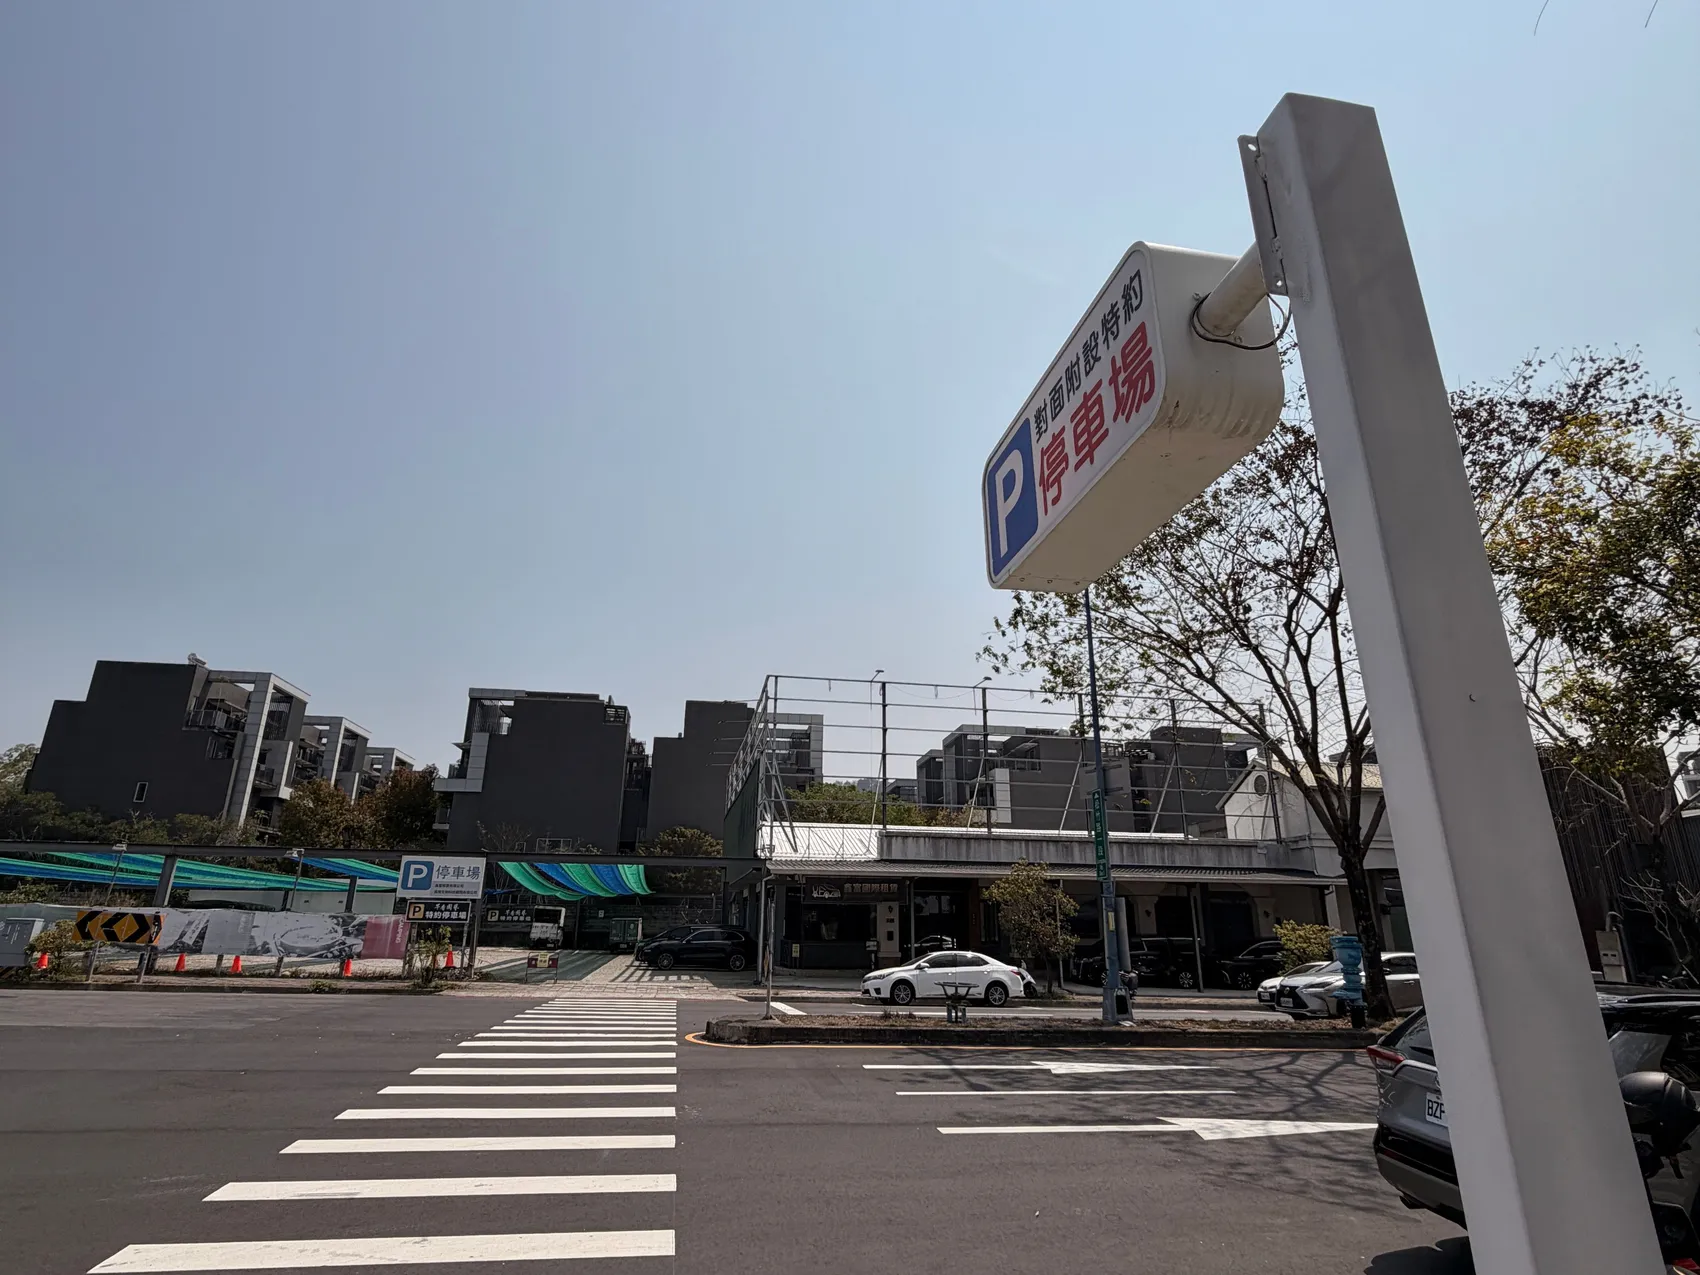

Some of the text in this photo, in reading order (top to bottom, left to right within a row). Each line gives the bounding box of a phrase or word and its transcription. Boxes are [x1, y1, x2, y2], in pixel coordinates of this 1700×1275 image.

[1034, 269, 1144, 443] 對面附設特約
[1038, 321, 1156, 516] 停車場
[995, 449, 1024, 559] P
[407, 864, 428, 888] P
[436, 865, 481, 880] 停車場
[412, 905, 421, 916] P
[425, 911, 467, 920] 特約停車場
